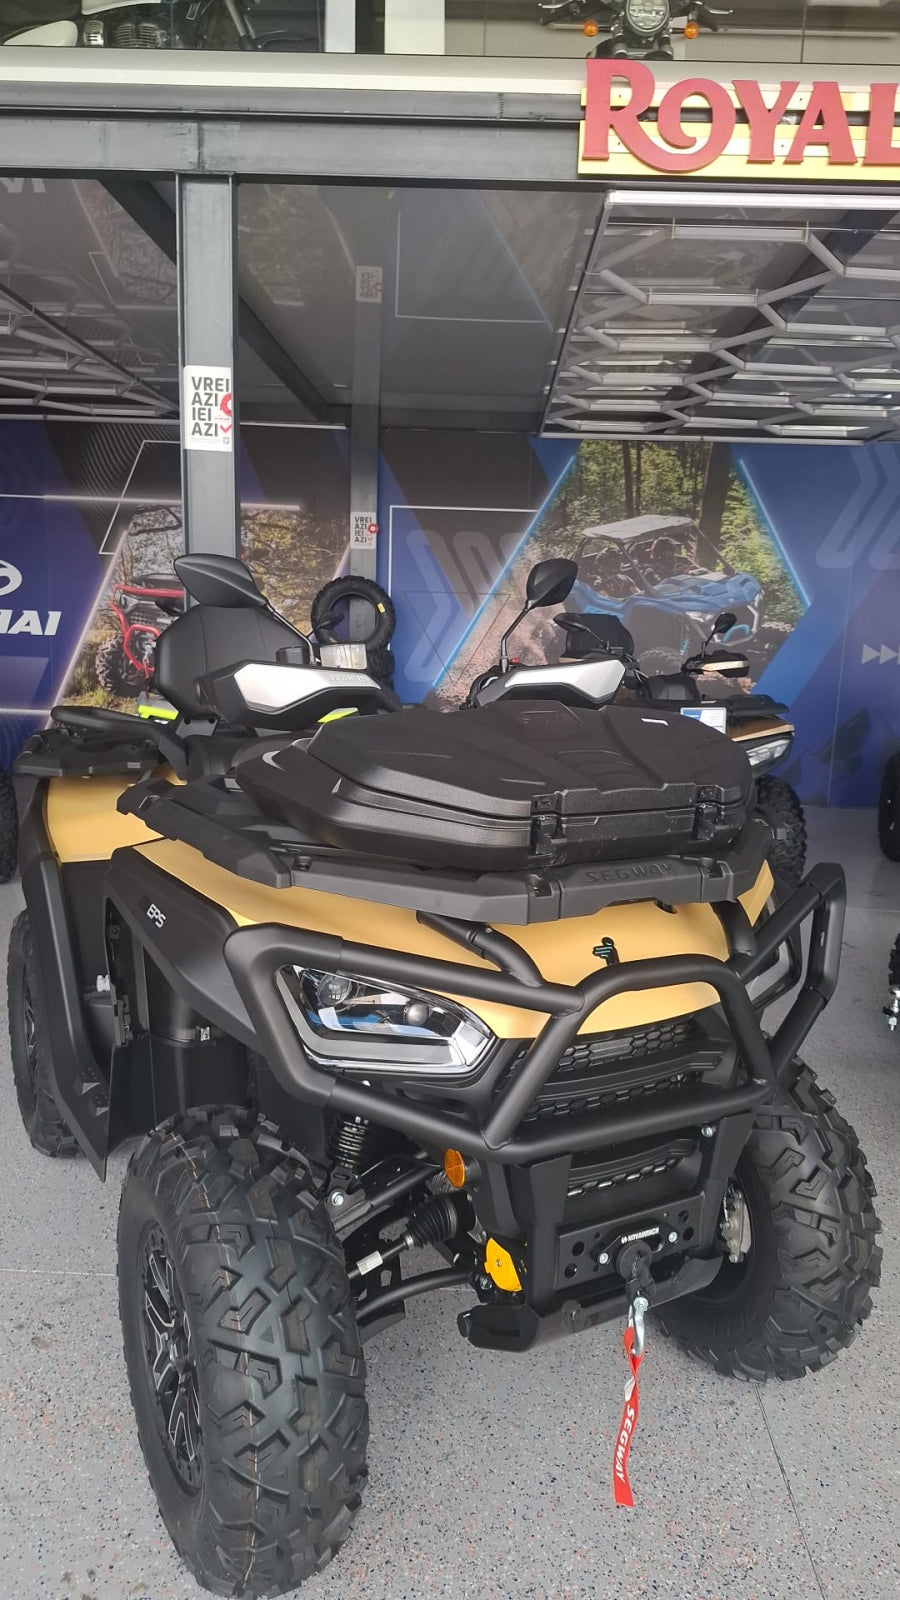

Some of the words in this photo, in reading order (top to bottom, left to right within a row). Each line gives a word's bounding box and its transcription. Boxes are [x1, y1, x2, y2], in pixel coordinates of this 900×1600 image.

[582, 58, 900, 173] ROYAL
[191, 376, 230, 393] VREI
[191, 391, 219, 407] AZI
[192, 407, 212, 422] IEI
[191, 422, 219, 437] AZI
[585, 863, 673, 883] SEGWAY
[146, 903, 167, 928] EPS
[615, 1404, 635, 1484] SEGWAY
